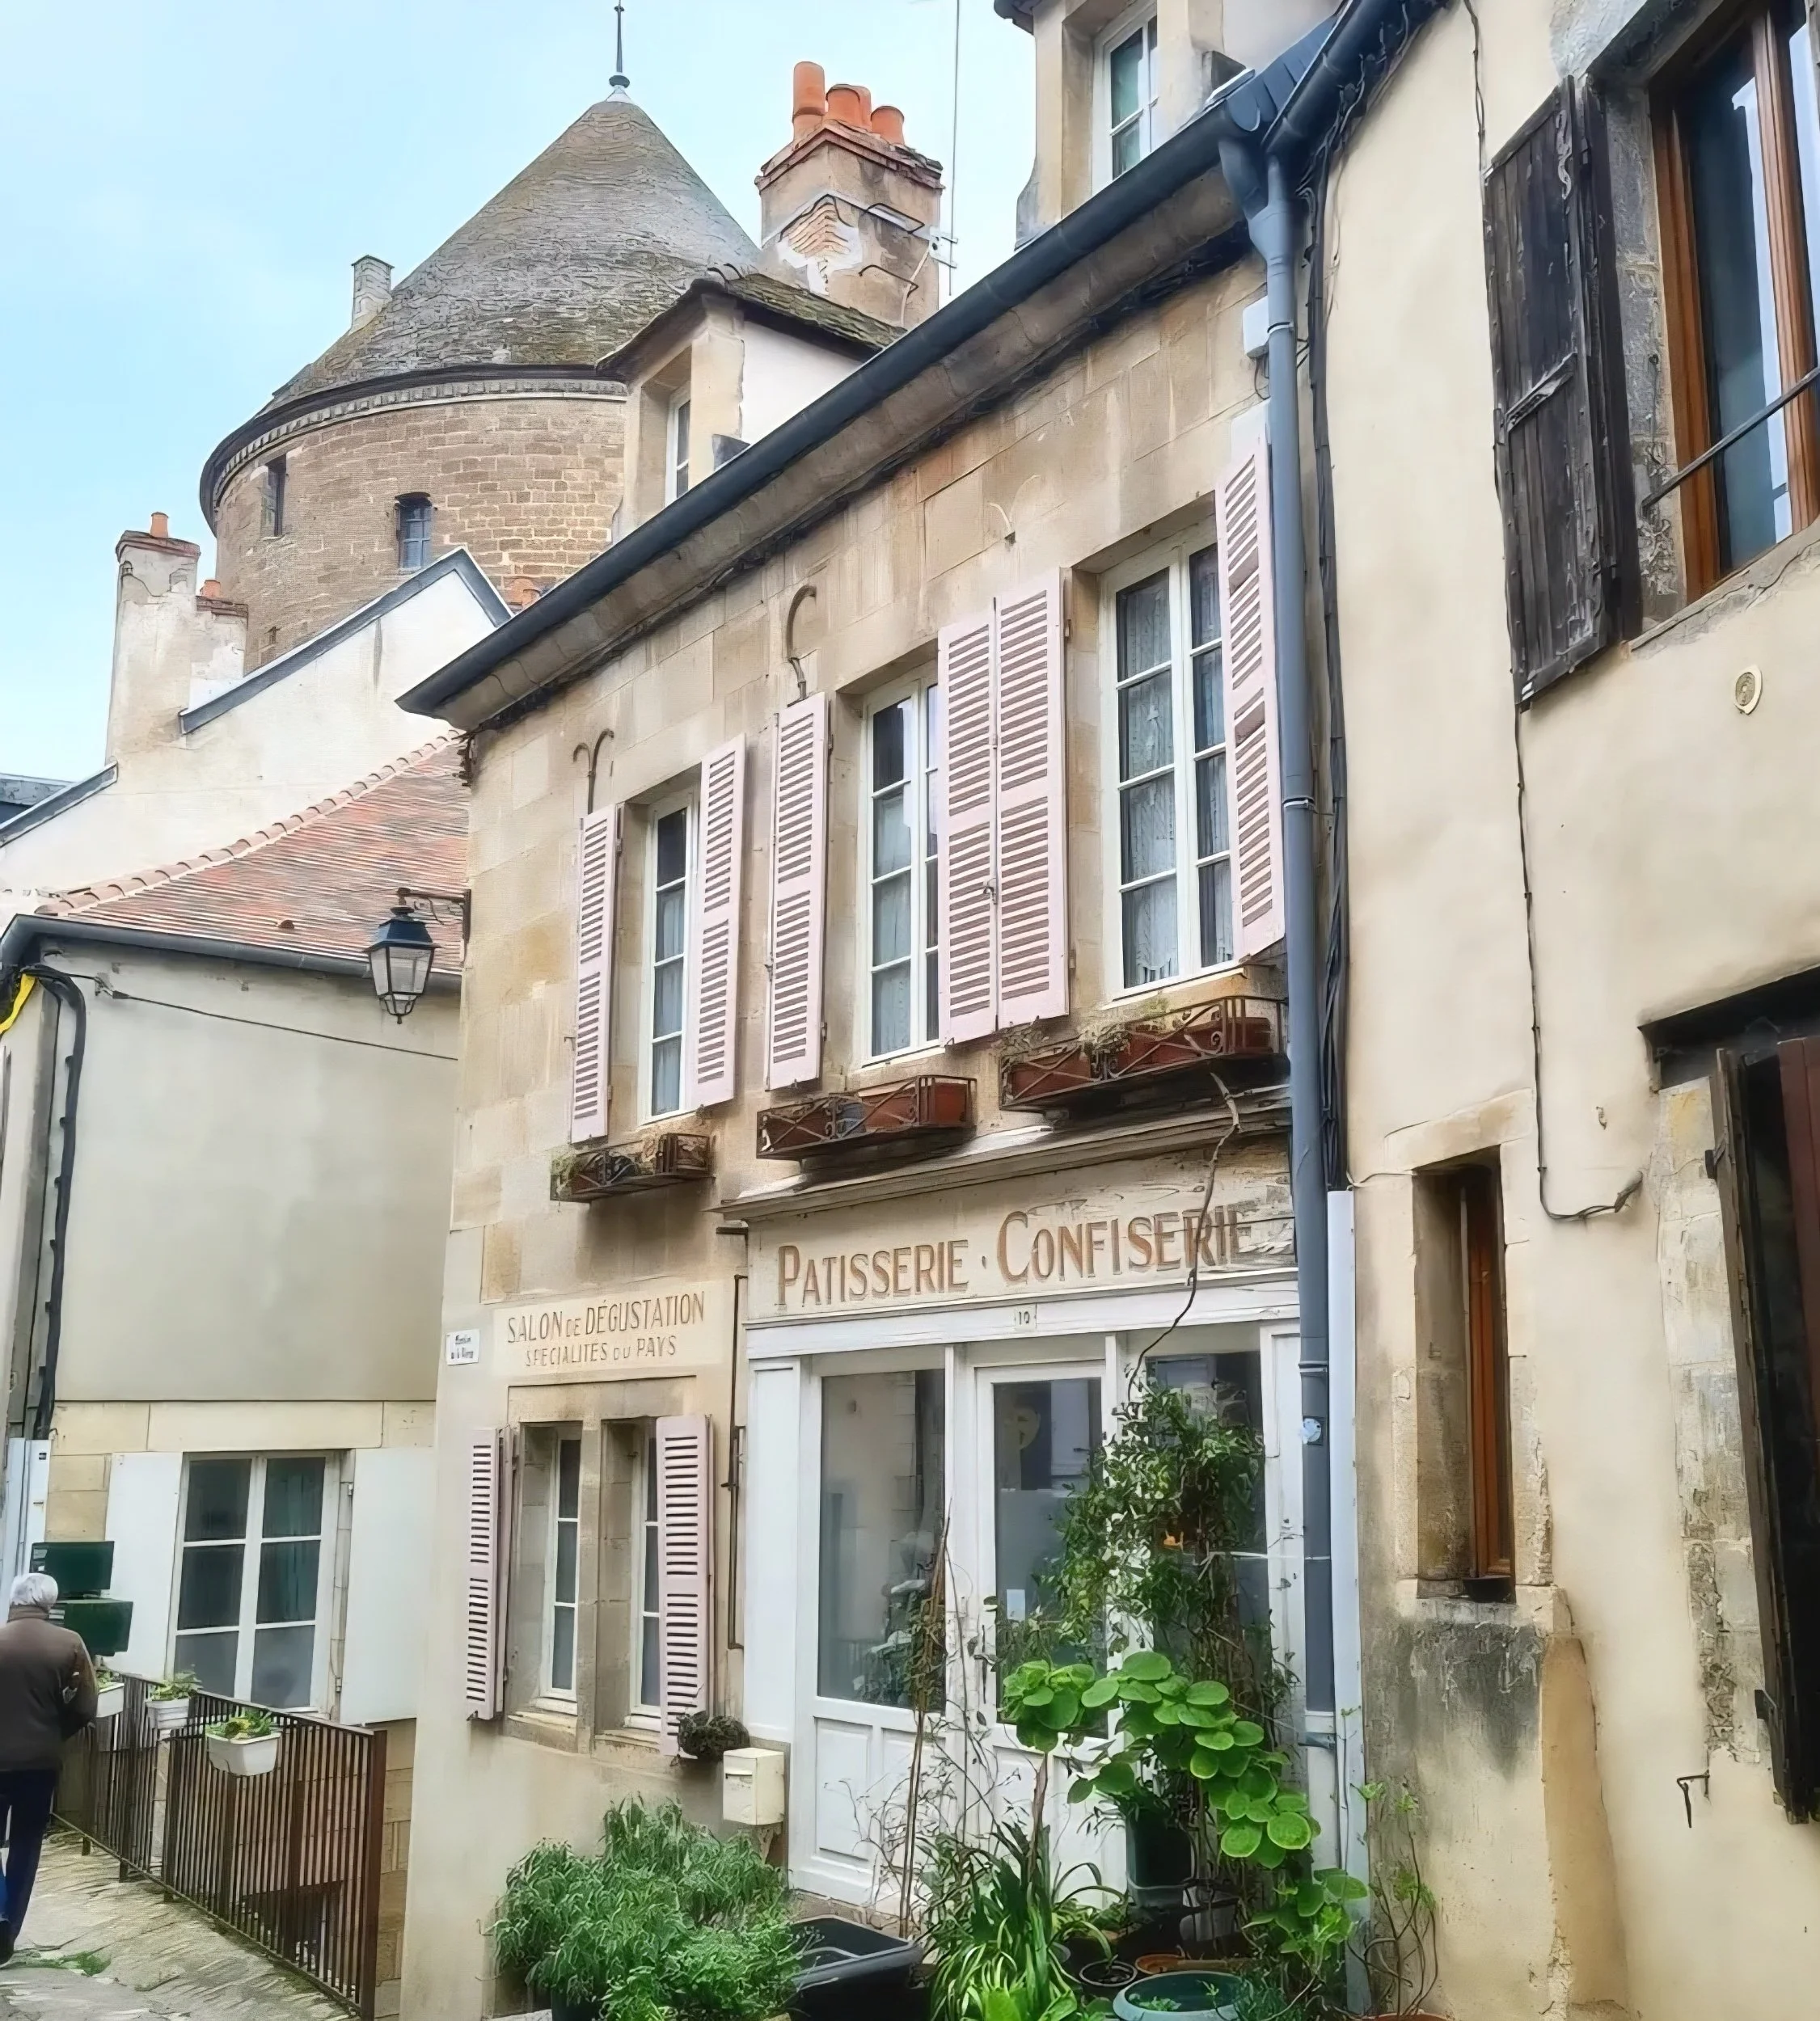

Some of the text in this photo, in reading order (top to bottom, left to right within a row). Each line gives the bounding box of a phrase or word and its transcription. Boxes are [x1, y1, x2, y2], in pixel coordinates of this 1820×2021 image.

[777, 1205, 1256, 1311] PATISSERIE CONFISERIE
[508, 1310, 563, 1344] SALON
[585, 1291, 704, 1335] DÉGUSTATION
[1019, 1310, 1030, 1325] 10
[637, 1335, 677, 1357] PAYS
